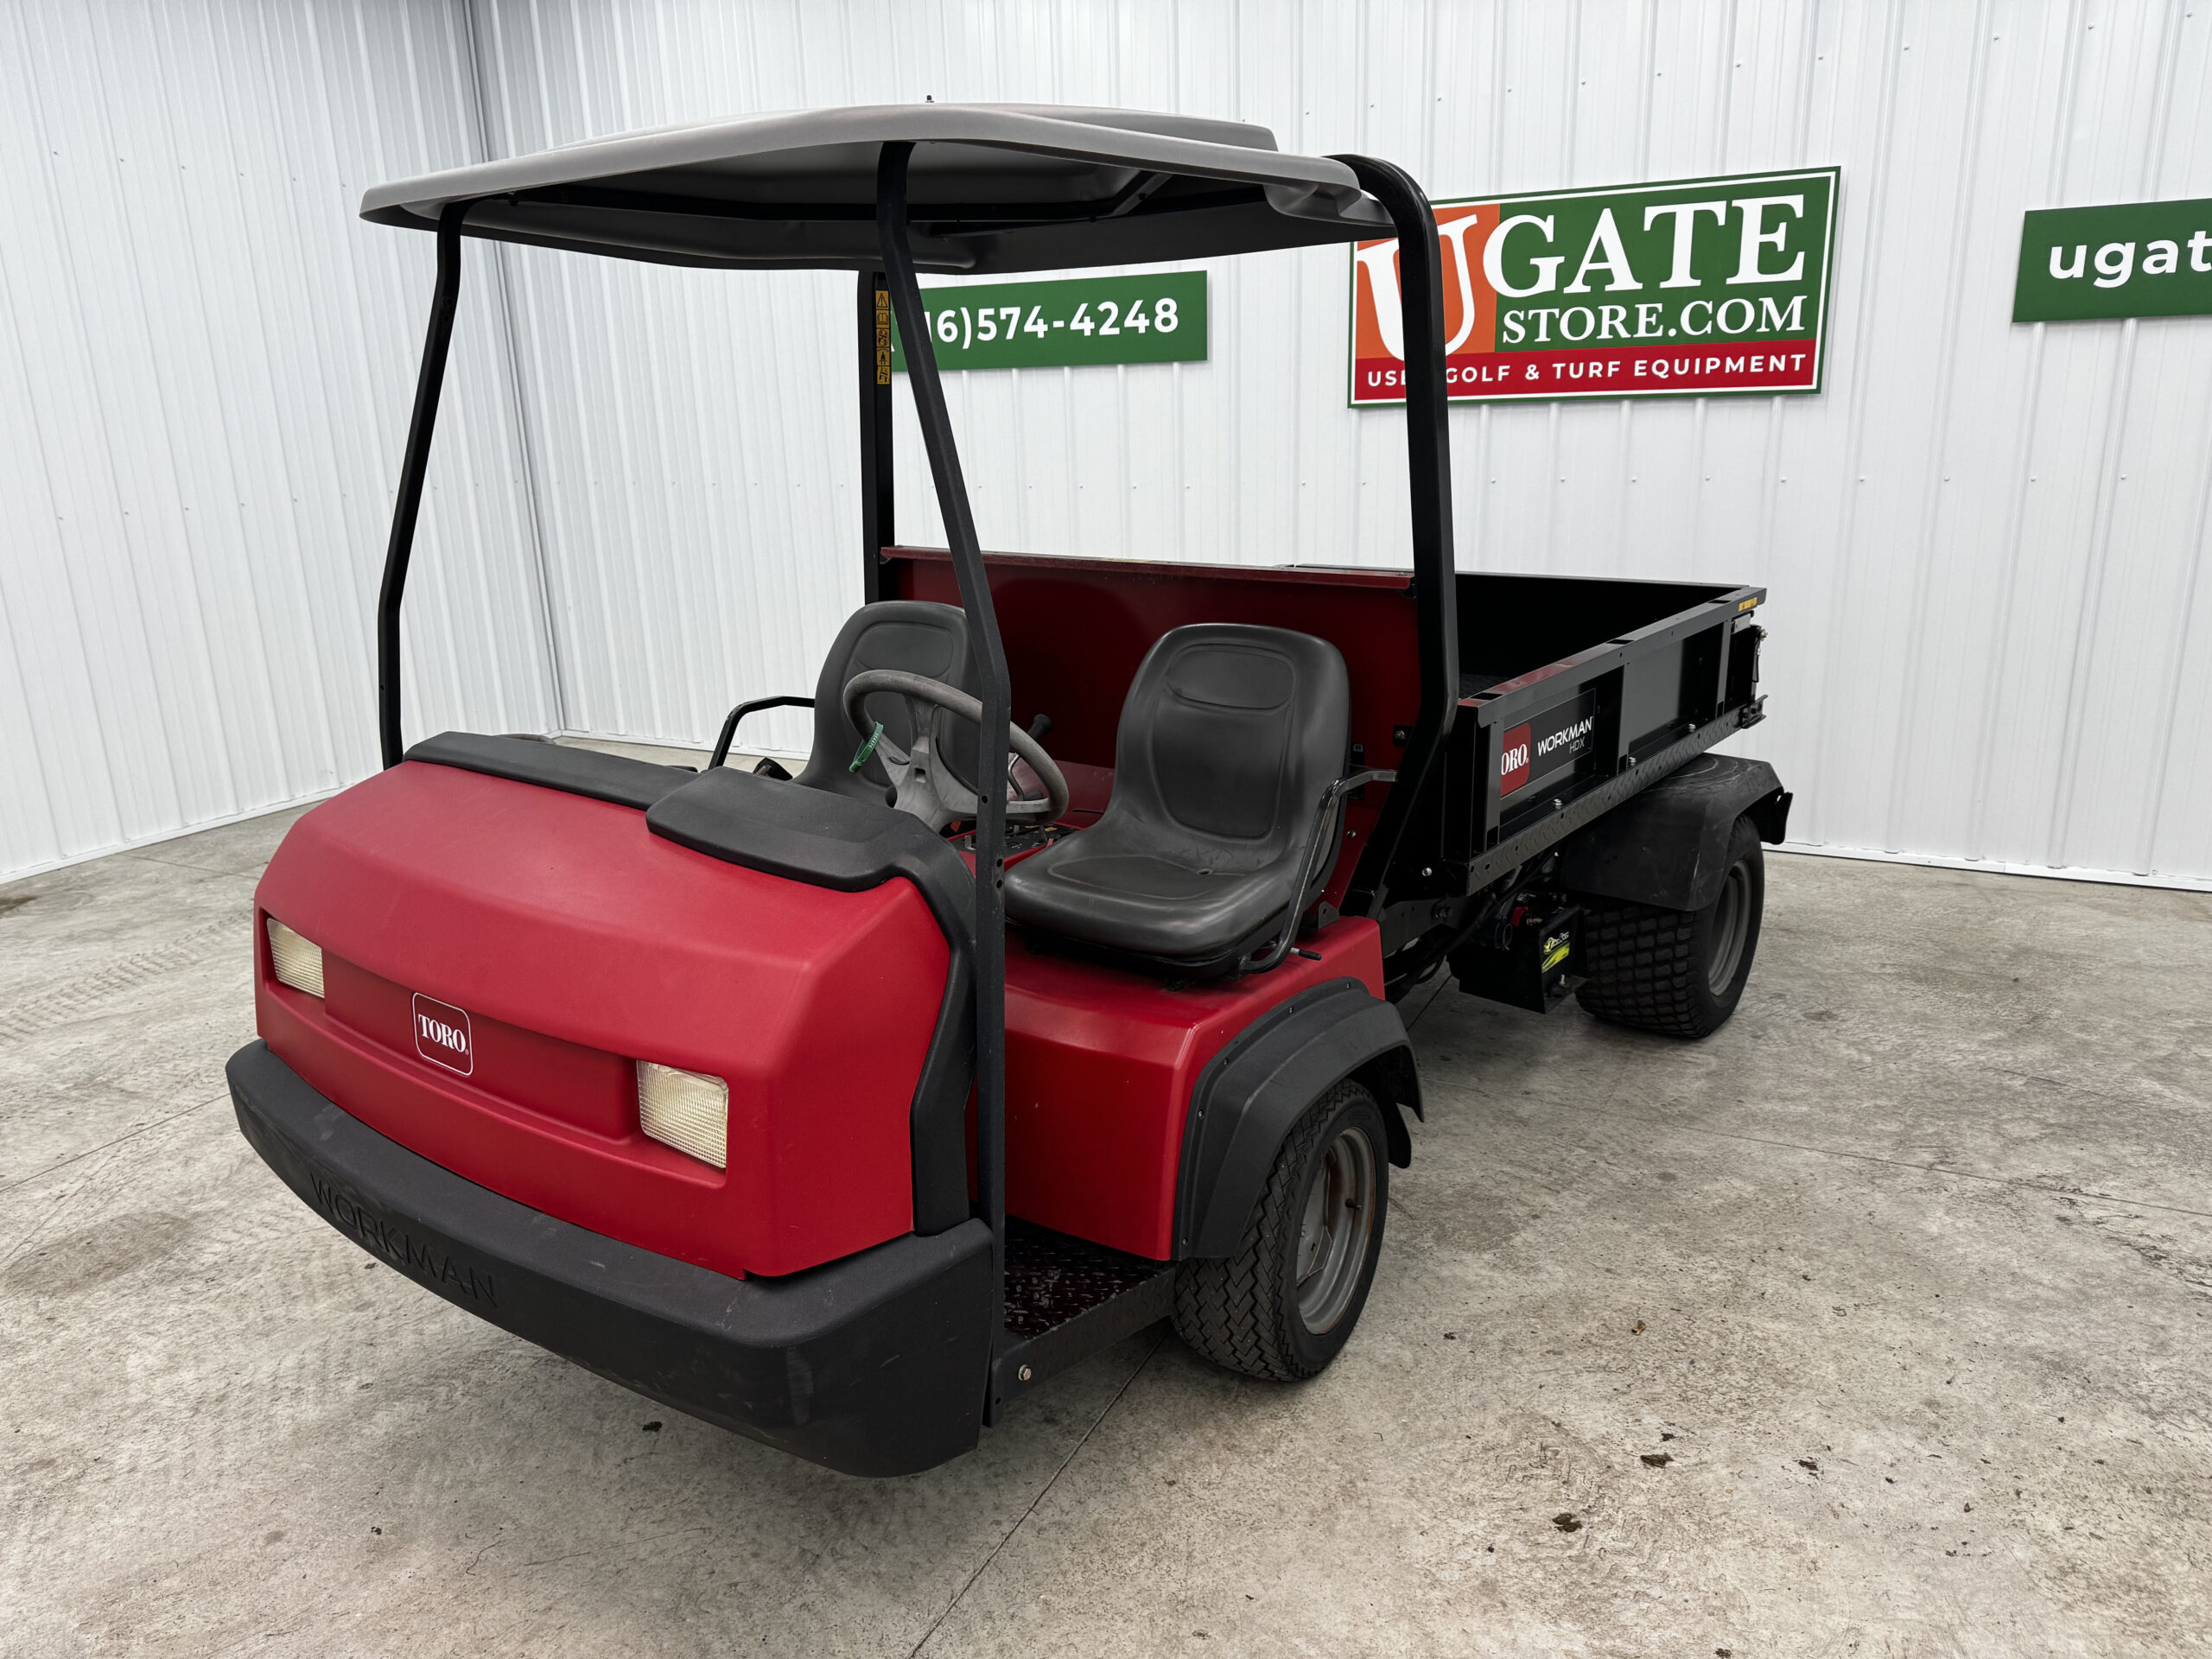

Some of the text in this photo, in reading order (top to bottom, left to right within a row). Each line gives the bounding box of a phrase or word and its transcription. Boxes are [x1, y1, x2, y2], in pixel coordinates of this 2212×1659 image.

[891, 297, 1179, 352] 6)574-4248
[1503, 296, 1808, 344] STORE.COM
[1368, 353, 1806, 387] US GOLF & TURF EQUIPMENT
[1501, 715, 1593, 775] ORO WORKMAN
[1569, 736, 1585, 753] HDX
[418, 1014, 467, 1052] TORO
[310, 1173, 499, 1308] WORKMAN
